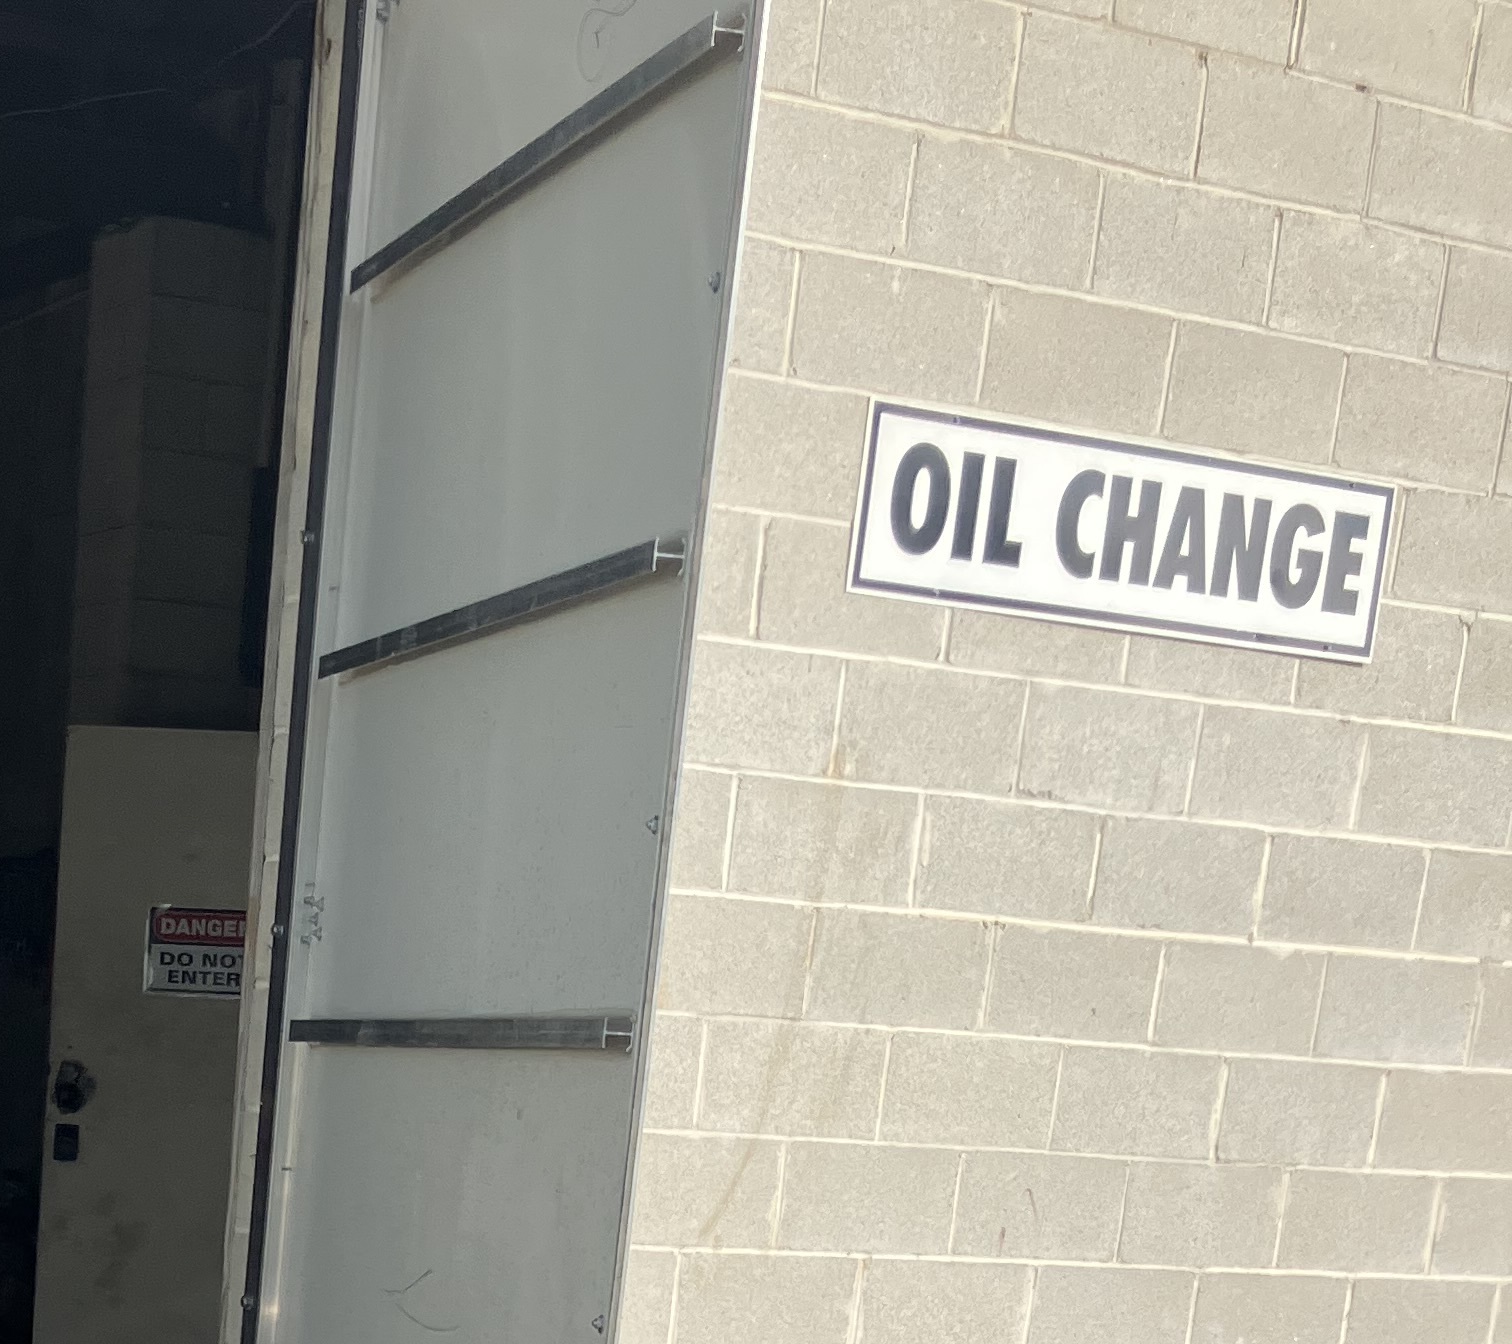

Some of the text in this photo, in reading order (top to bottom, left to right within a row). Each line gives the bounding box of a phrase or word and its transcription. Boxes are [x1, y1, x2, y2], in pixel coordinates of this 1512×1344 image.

[890, 441, 1371, 617] OIL CHANGE
[160, 952, 244, 969] DO NO
[167, 970, 240, 987] ENTER
